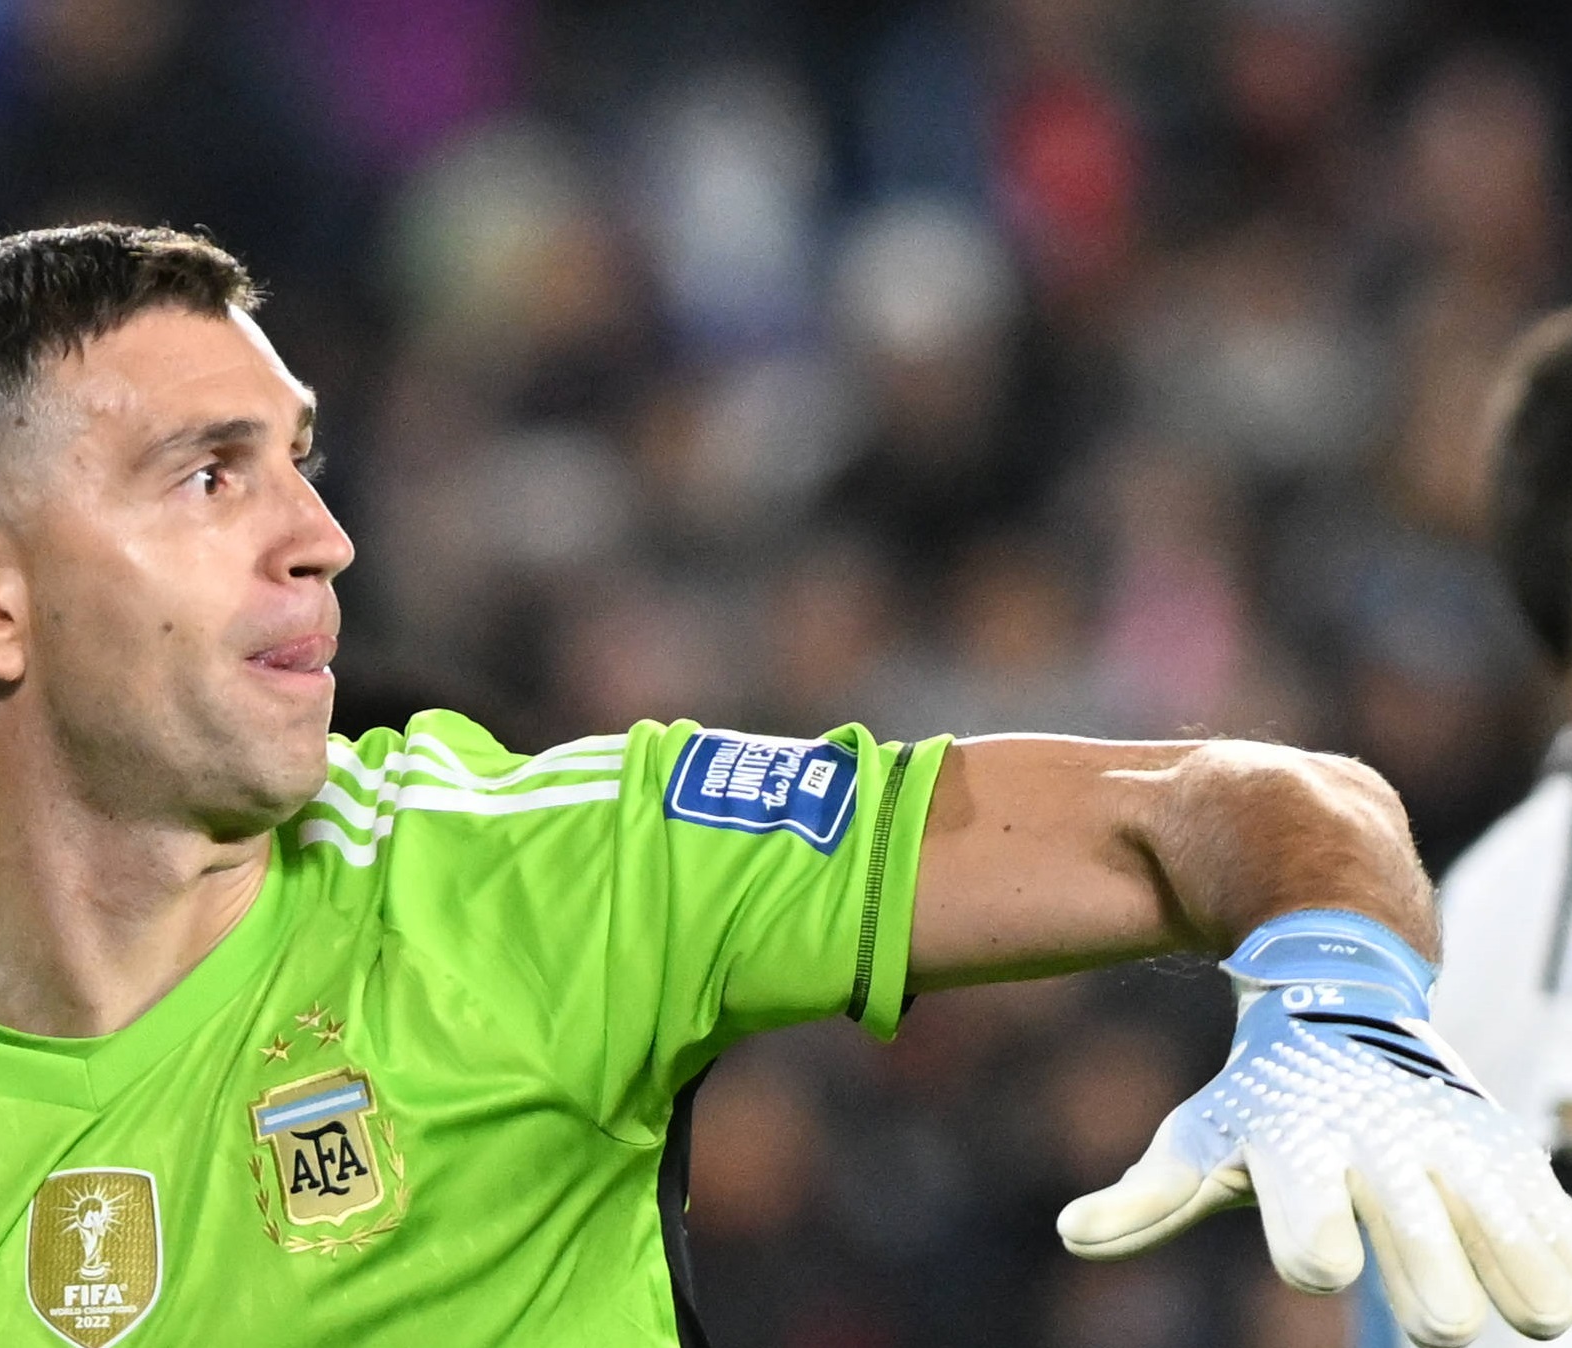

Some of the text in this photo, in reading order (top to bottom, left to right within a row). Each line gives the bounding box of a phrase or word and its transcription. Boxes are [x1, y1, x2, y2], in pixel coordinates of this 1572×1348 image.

[700, 741, 746, 798] FOOTBALL
[725, 742, 779, 801] UNITES
[807, 764, 829, 790] FIFA
[761, 778, 790, 811] the
[290, 1120, 369, 1197] AFA
[74, 1315, 111, 1329] 2022
